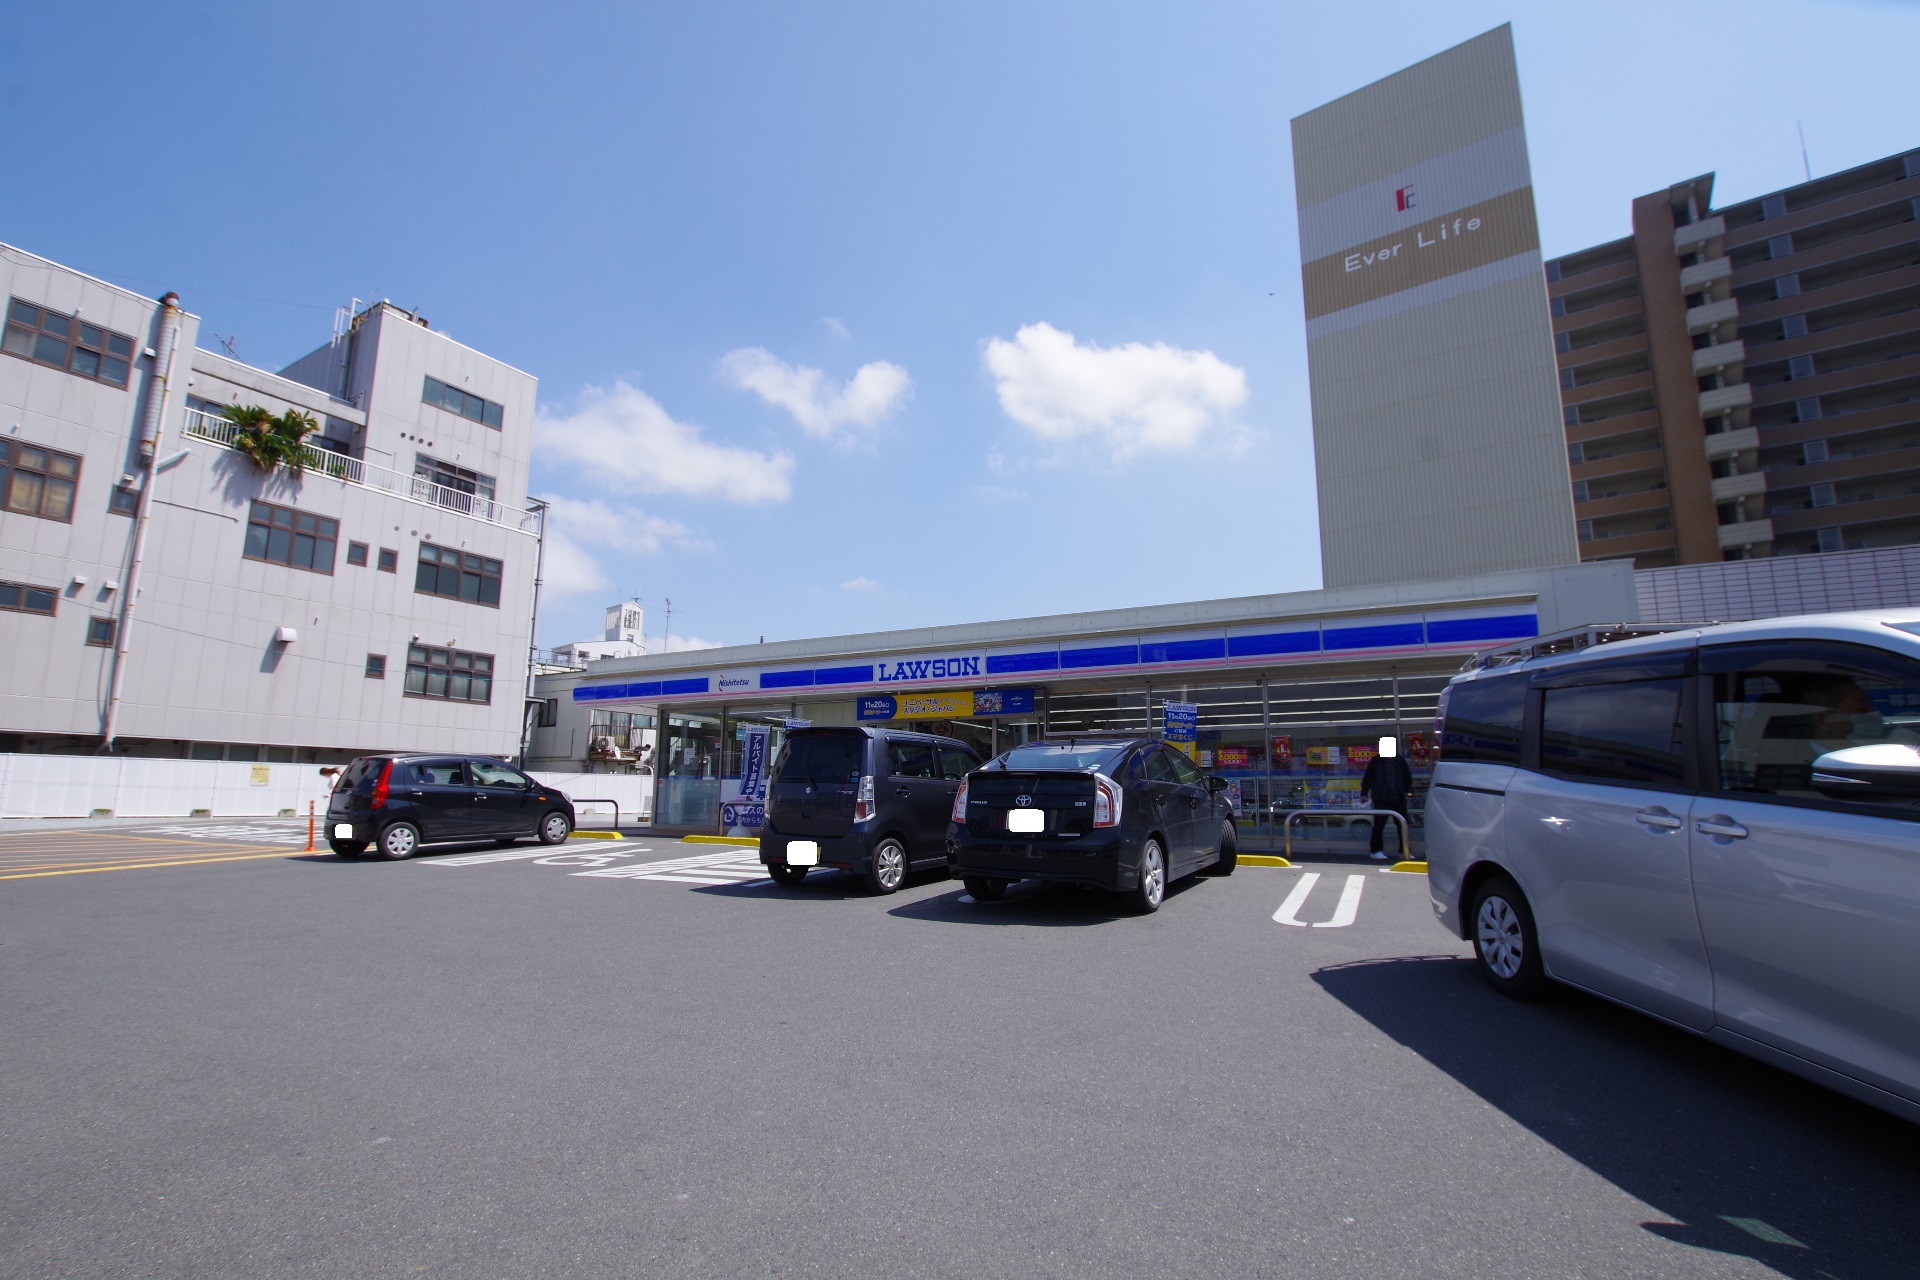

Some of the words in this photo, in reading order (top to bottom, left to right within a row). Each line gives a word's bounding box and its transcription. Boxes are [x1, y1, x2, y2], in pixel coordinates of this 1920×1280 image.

[1344, 243, 1403, 273] Ever
[1417, 218, 1481, 248] Life
[718, 677, 750, 689] Nishitetsu
[878, 656, 981, 682] LAWSON
[745, 735, 762, 794] アルバイト募集中
